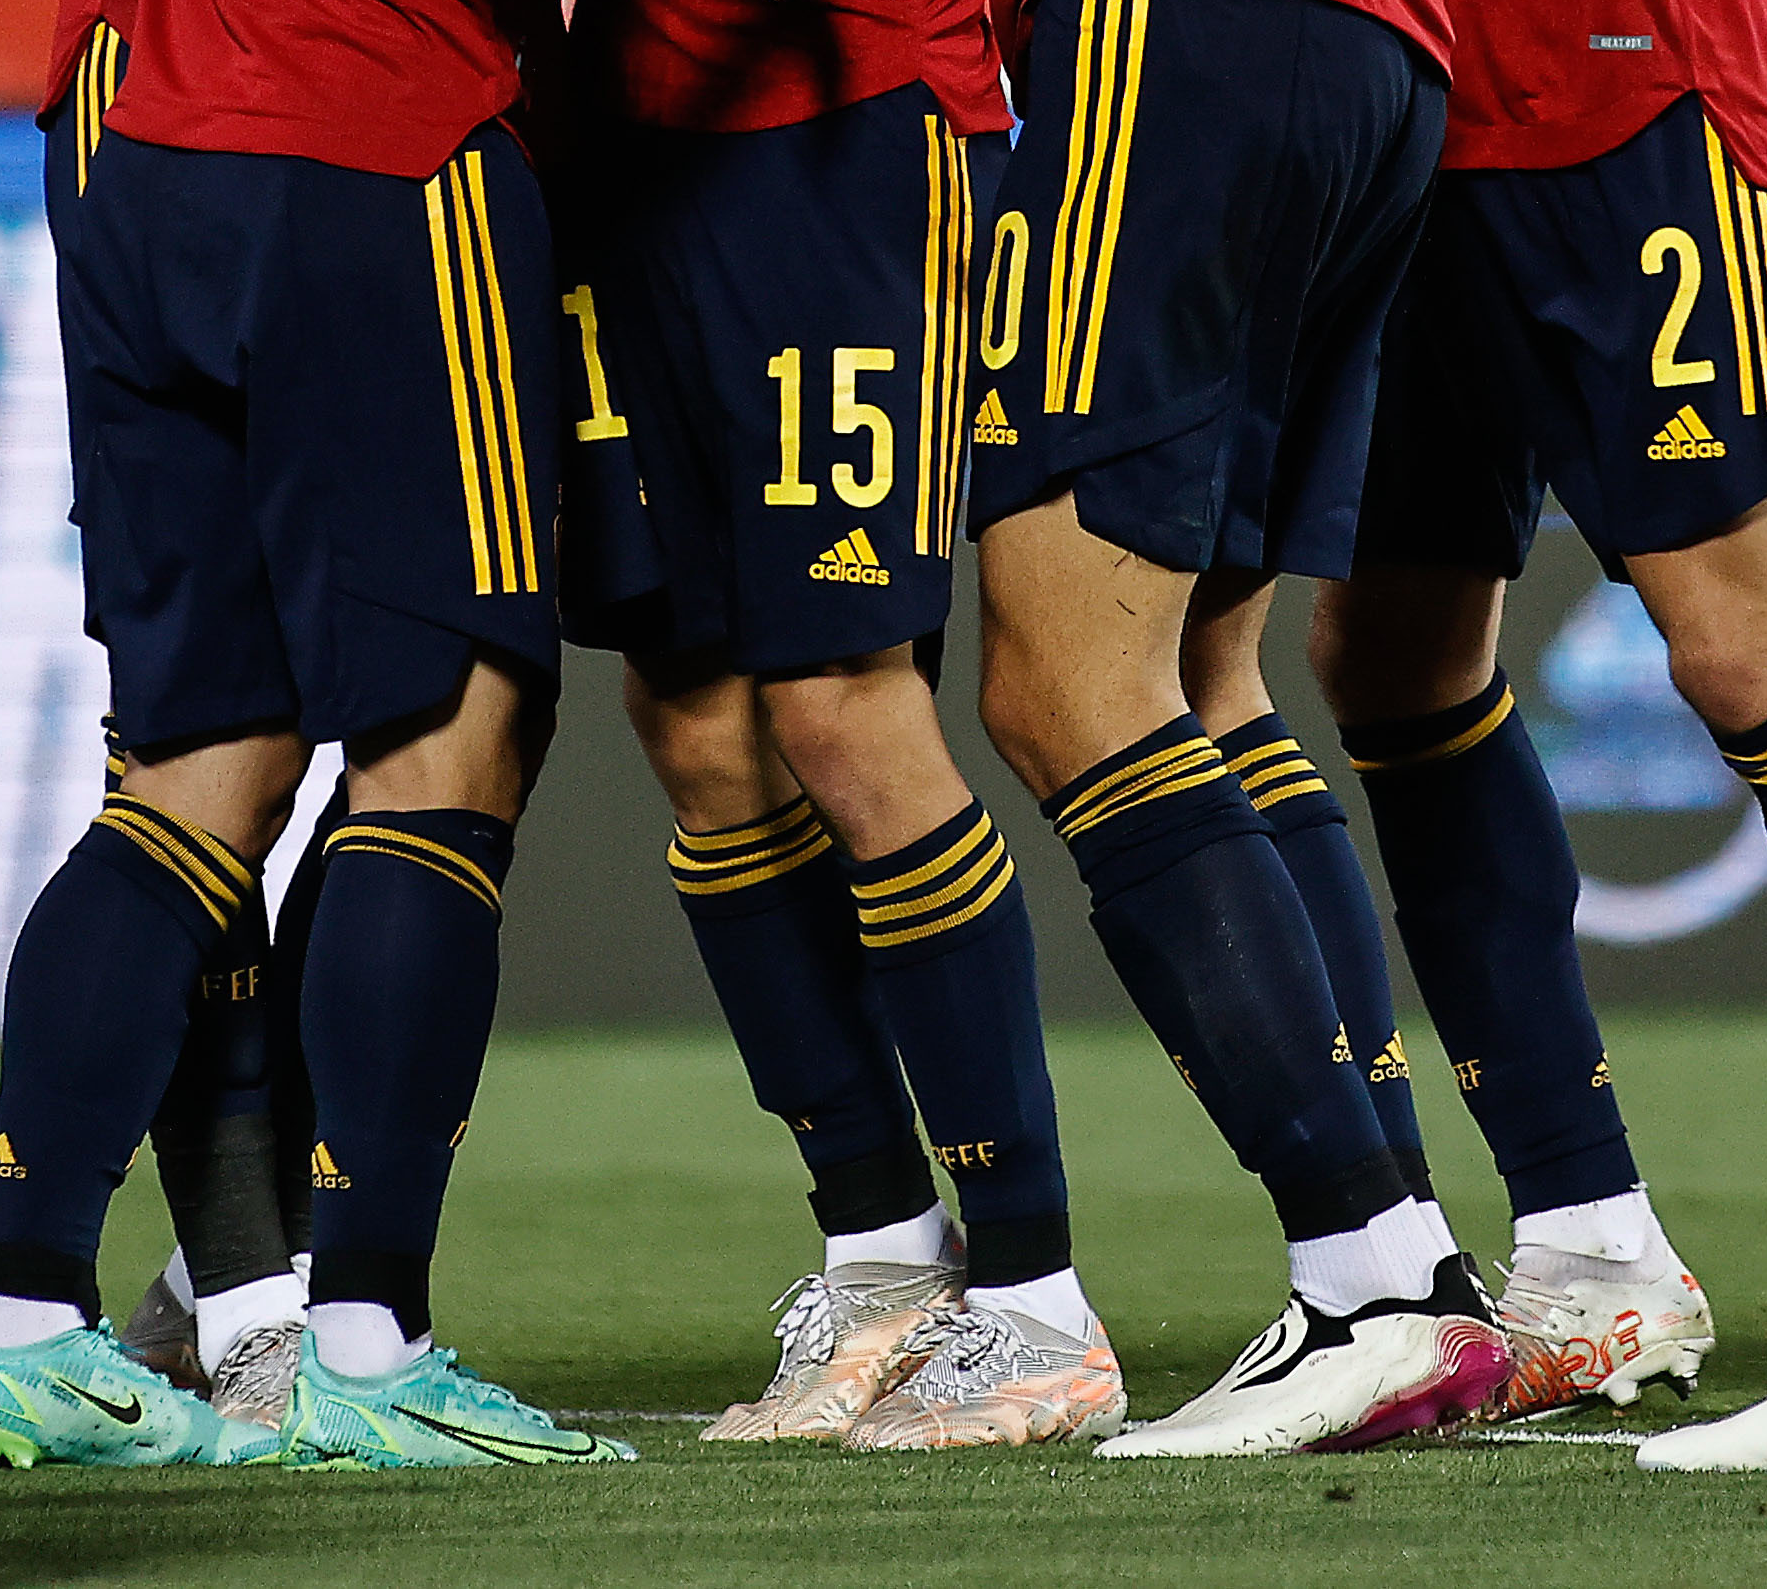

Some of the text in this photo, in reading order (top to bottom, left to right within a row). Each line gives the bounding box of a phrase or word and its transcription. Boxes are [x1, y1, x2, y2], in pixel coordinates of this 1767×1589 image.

[562, 285, 629, 442] 1
[980, 211, 1029, 370] 0
[1641, 228, 1716, 388] 2
[764, 347, 896, 508] 15
[1647, 437, 1727, 460] adidas
[809, 559, 891, 586] adidas
